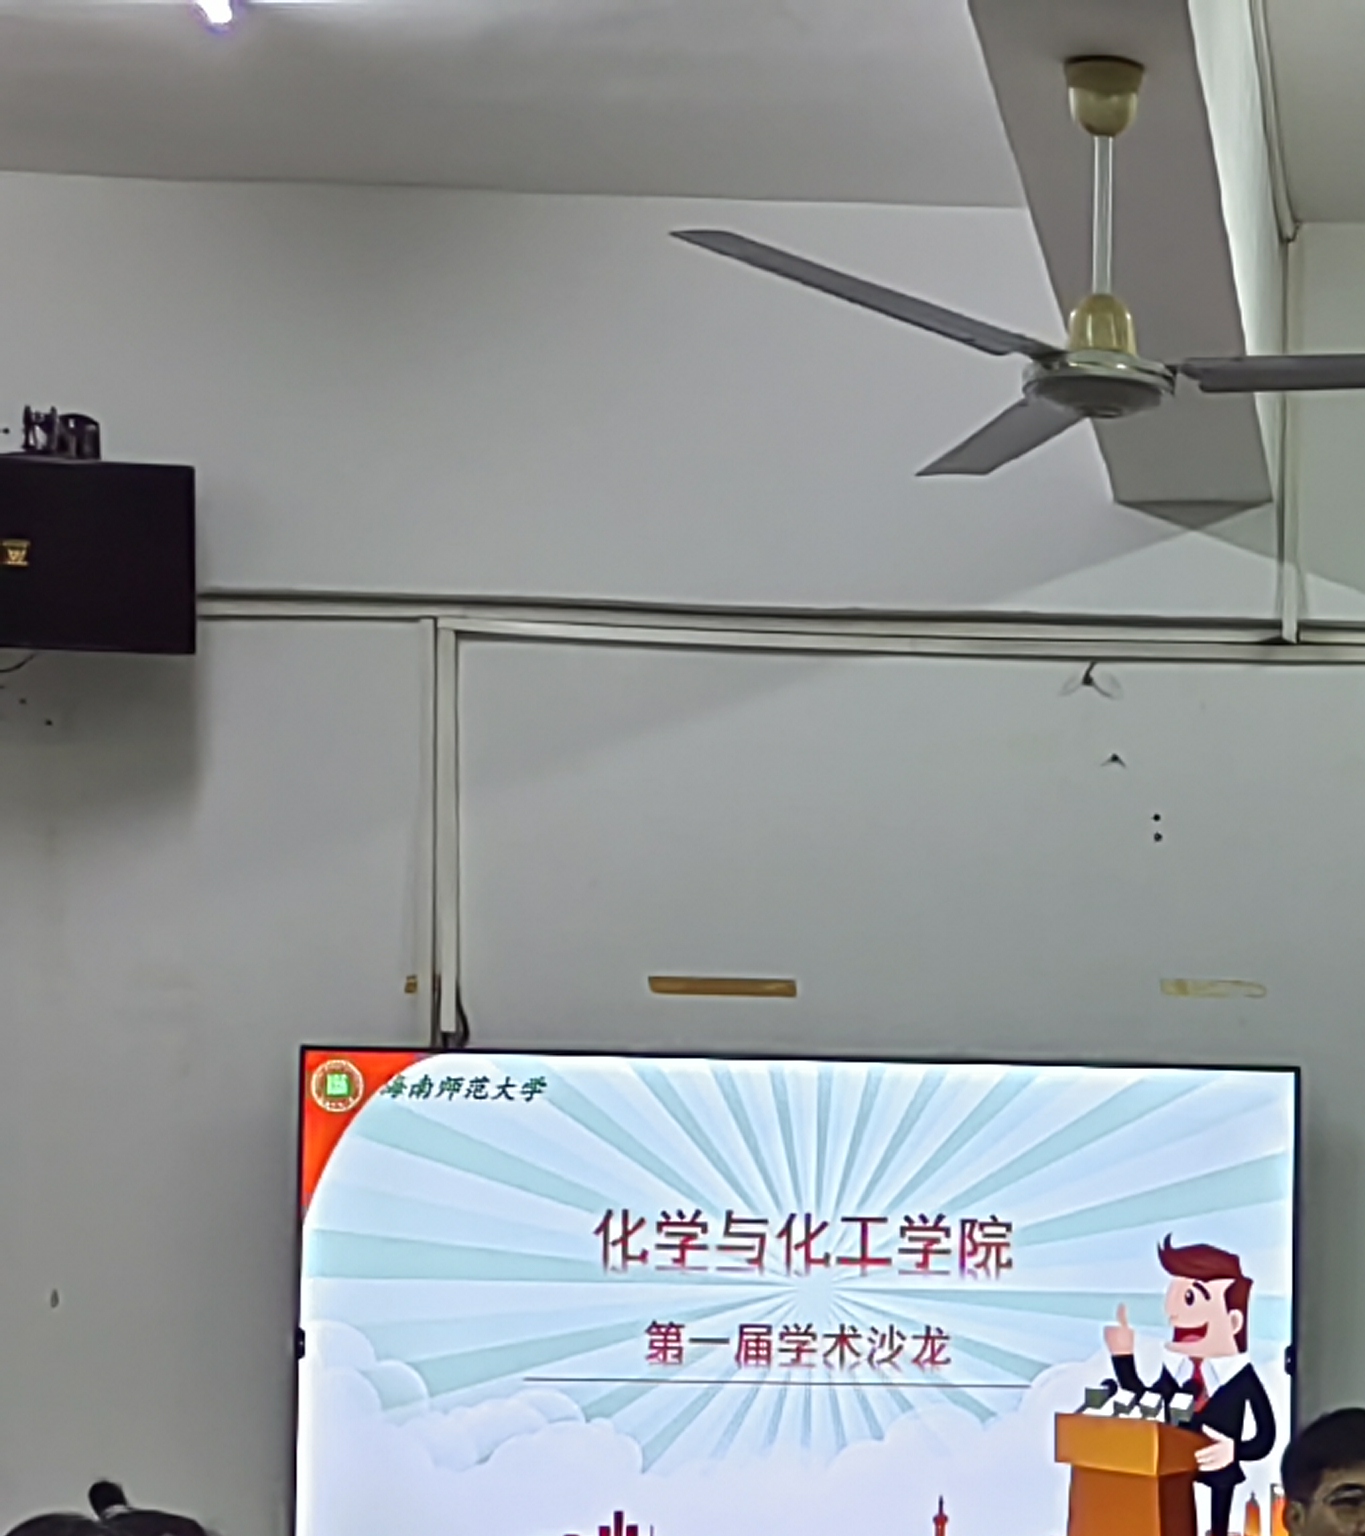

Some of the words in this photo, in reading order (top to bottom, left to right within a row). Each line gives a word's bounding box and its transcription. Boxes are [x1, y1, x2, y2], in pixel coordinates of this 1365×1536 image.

[593, 1208, 1013, 1272] 化学与化工学院
[644, 1320, 952, 1367] 第一届学术沙龙
